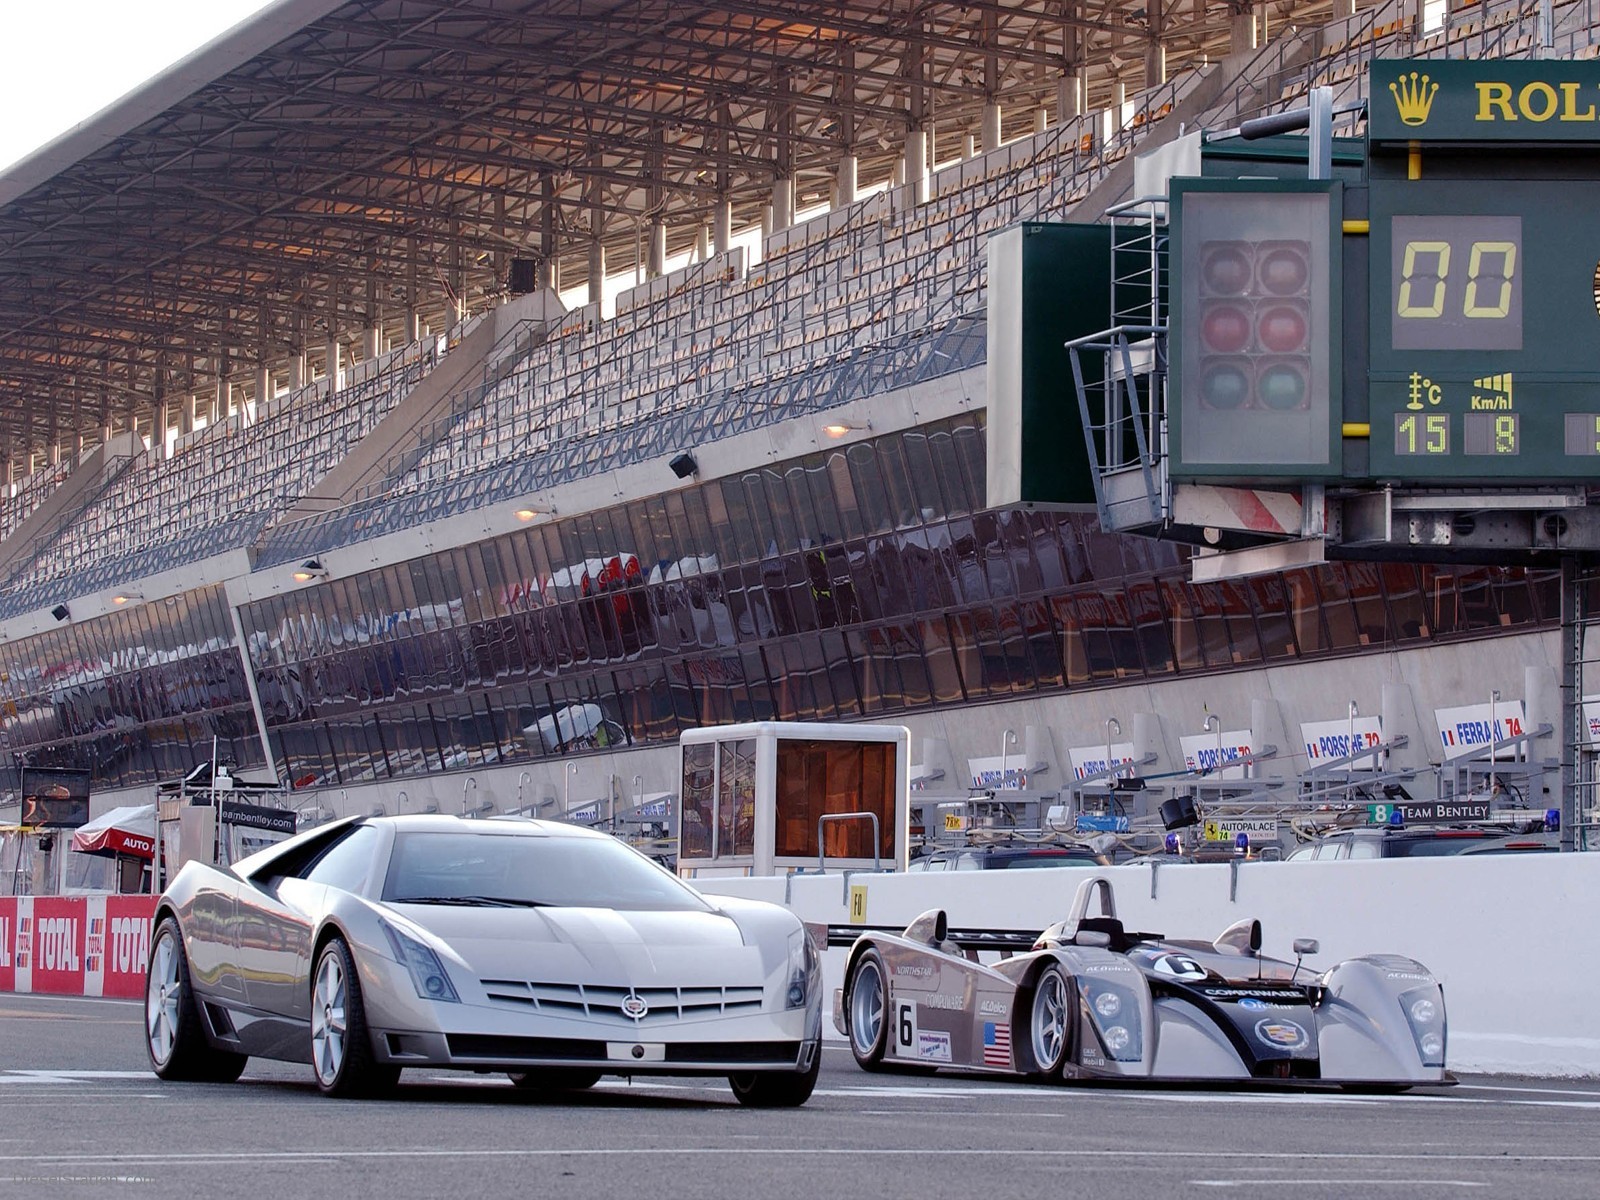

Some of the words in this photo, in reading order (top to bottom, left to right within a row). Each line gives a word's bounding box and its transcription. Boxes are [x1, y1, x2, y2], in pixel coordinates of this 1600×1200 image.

[1475, 82, 1600, 122] ROL
[1398, 241, 1517, 318] 00
[1471, 396, 1508, 410] Km/h
[1400, 416, 1446, 453] 15
[1456, 719, 1503, 745] FERRARI
[1505, 718, 1523, 737] 74
[1319, 733, 1363, 758] PORSCHE
[222, 810, 292, 828] eambentley.com
[1375, 804, 1387, 823] 8
[1398, 805, 1432, 819] TEAM
[1437, 804, 1488, 818] BENTLEY
[1115, 816, 1128, 831] 72
[1220, 822, 1275, 832] AUTOPALACE
[123, 837, 150, 851] AUTO
[1219, 831, 1228, 840] 74
[38, 917, 79, 971] TOTAL
[88, 936, 102, 953] TOTAL
[111, 916, 153, 974] TOTA
[896, 966, 932, 976] NORTHSTAR
[1204, 988, 1303, 998] COMPUWARE
[900, 1005, 913, 1047] 6
